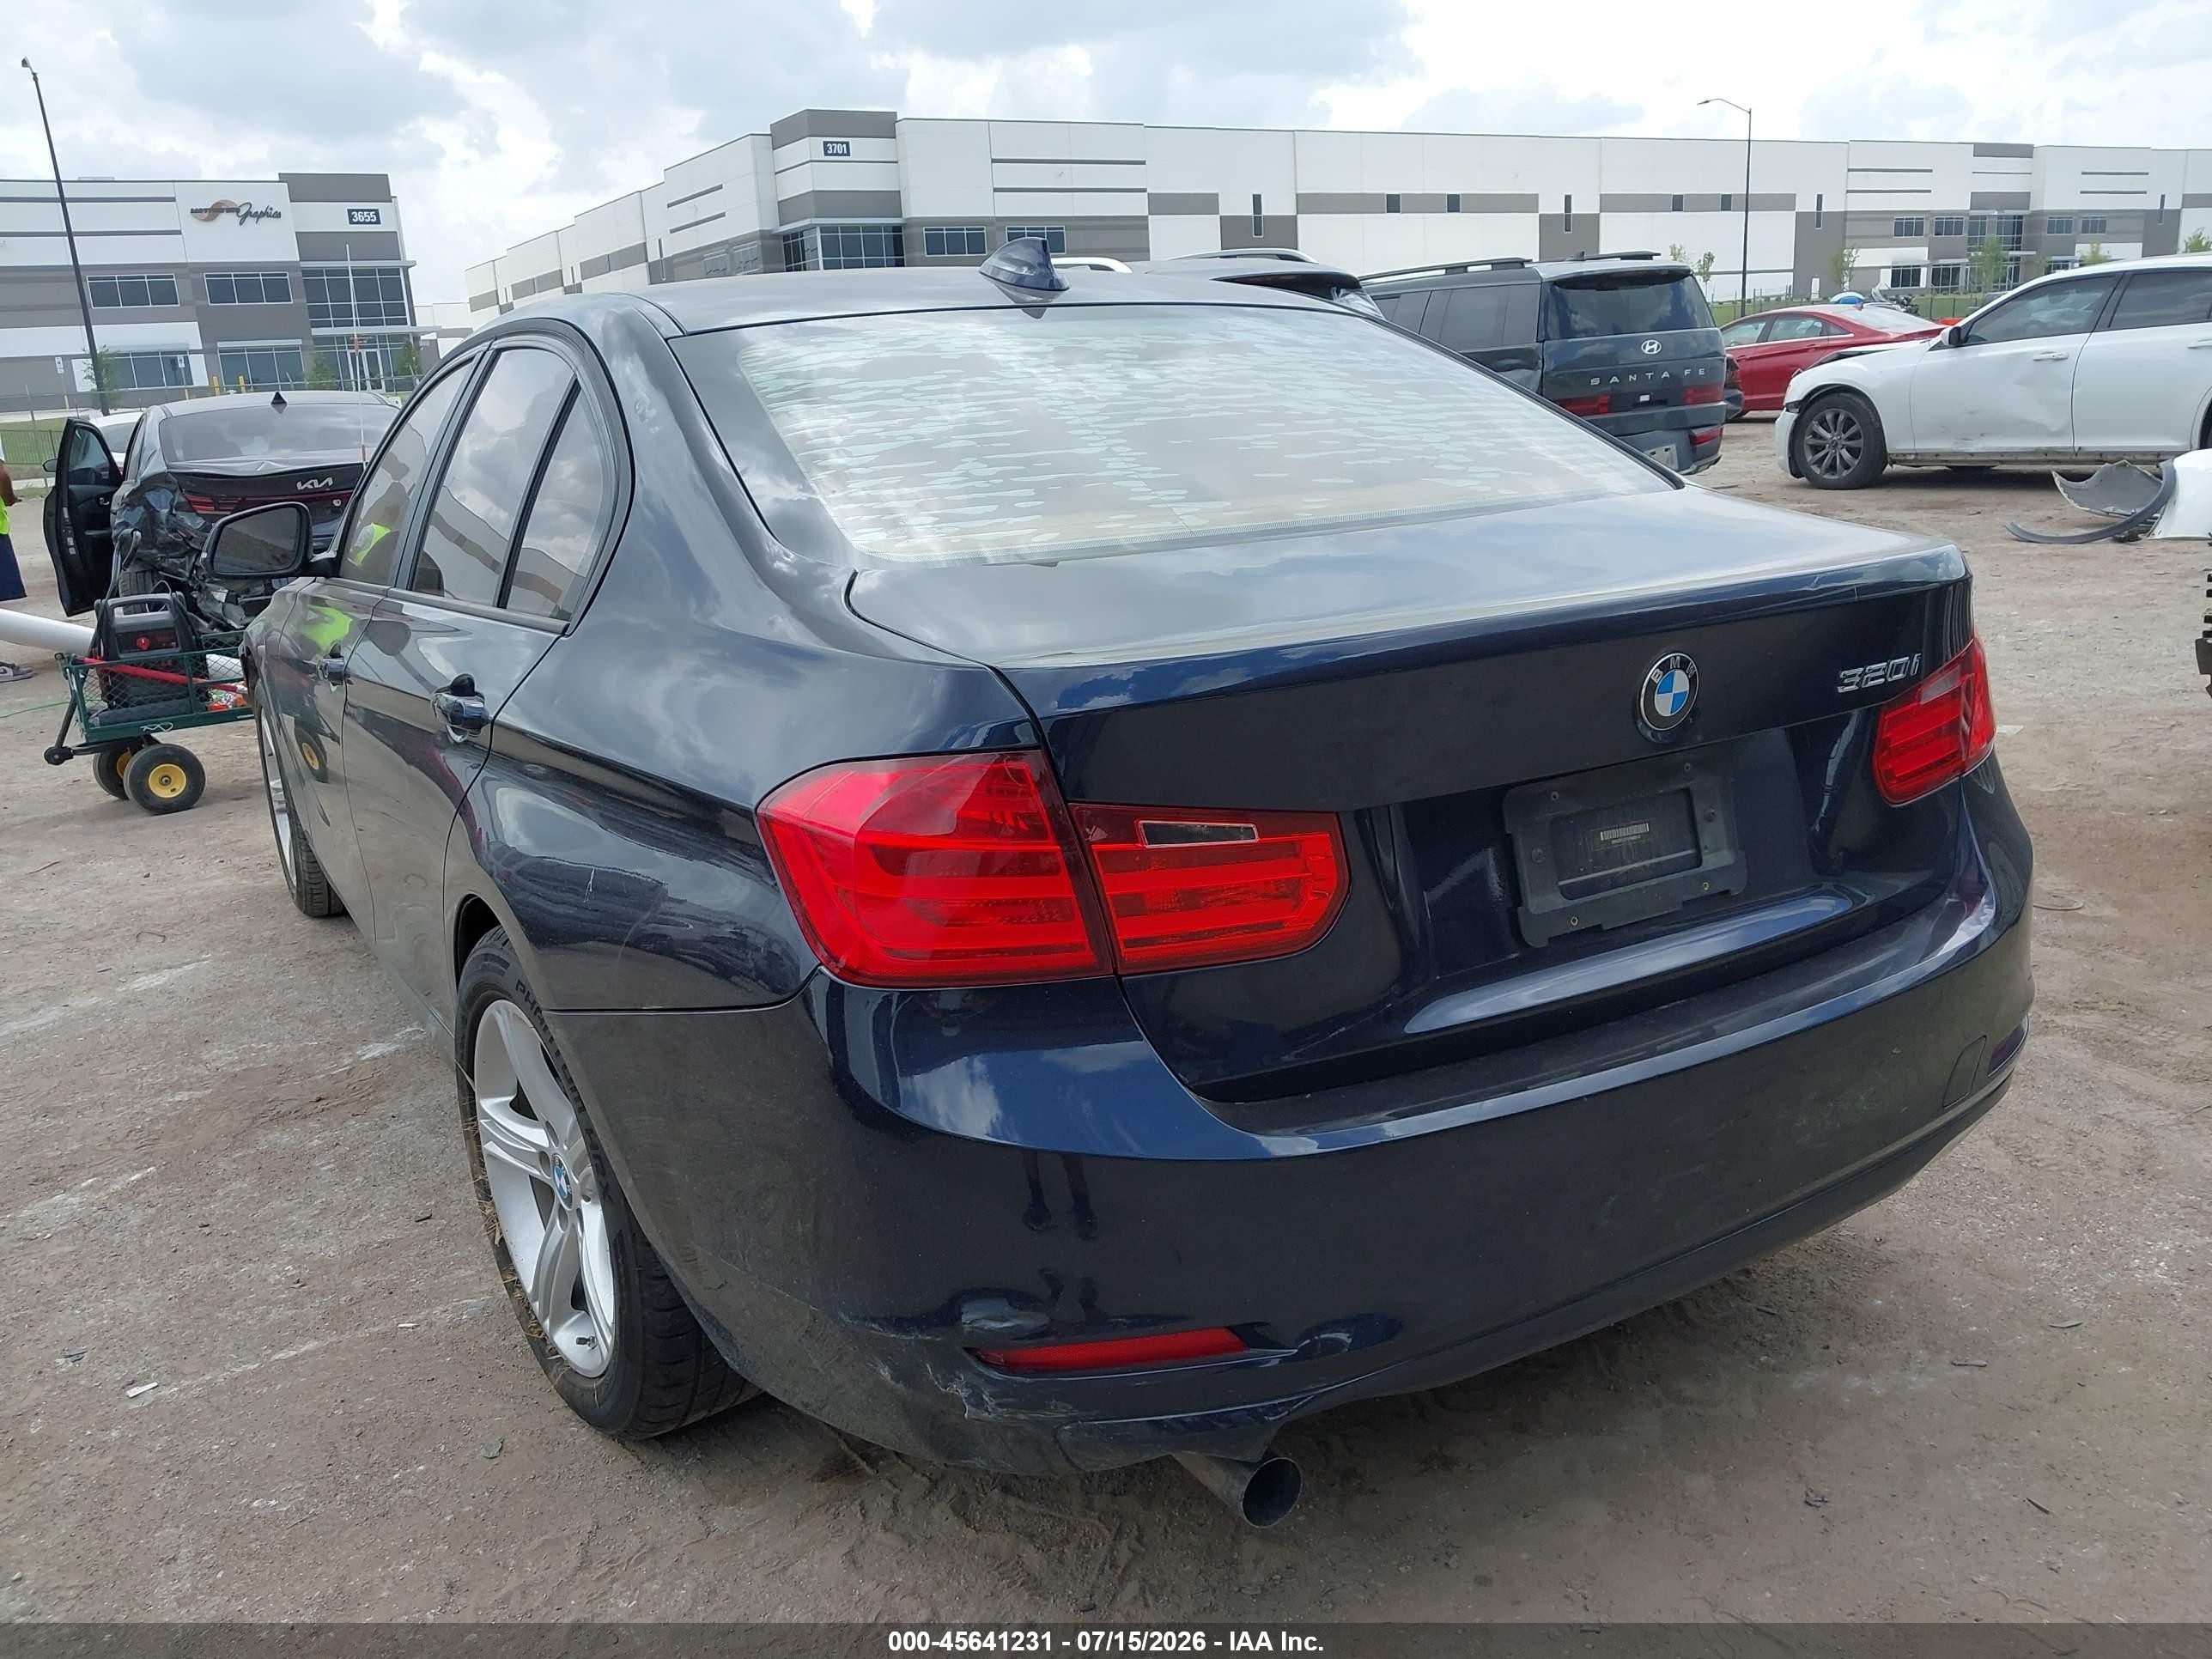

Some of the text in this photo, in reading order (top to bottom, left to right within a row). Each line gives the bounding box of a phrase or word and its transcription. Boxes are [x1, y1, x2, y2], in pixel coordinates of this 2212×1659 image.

[827, 143, 847, 154] 3701
[236, 202, 282, 226] Graphics
[351, 211, 377, 222] 3655
[1590, 368, 1705, 386] SANTA FE
[1650, 655, 1697, 684] BMW
[1838, 653, 1922, 693] 320i
